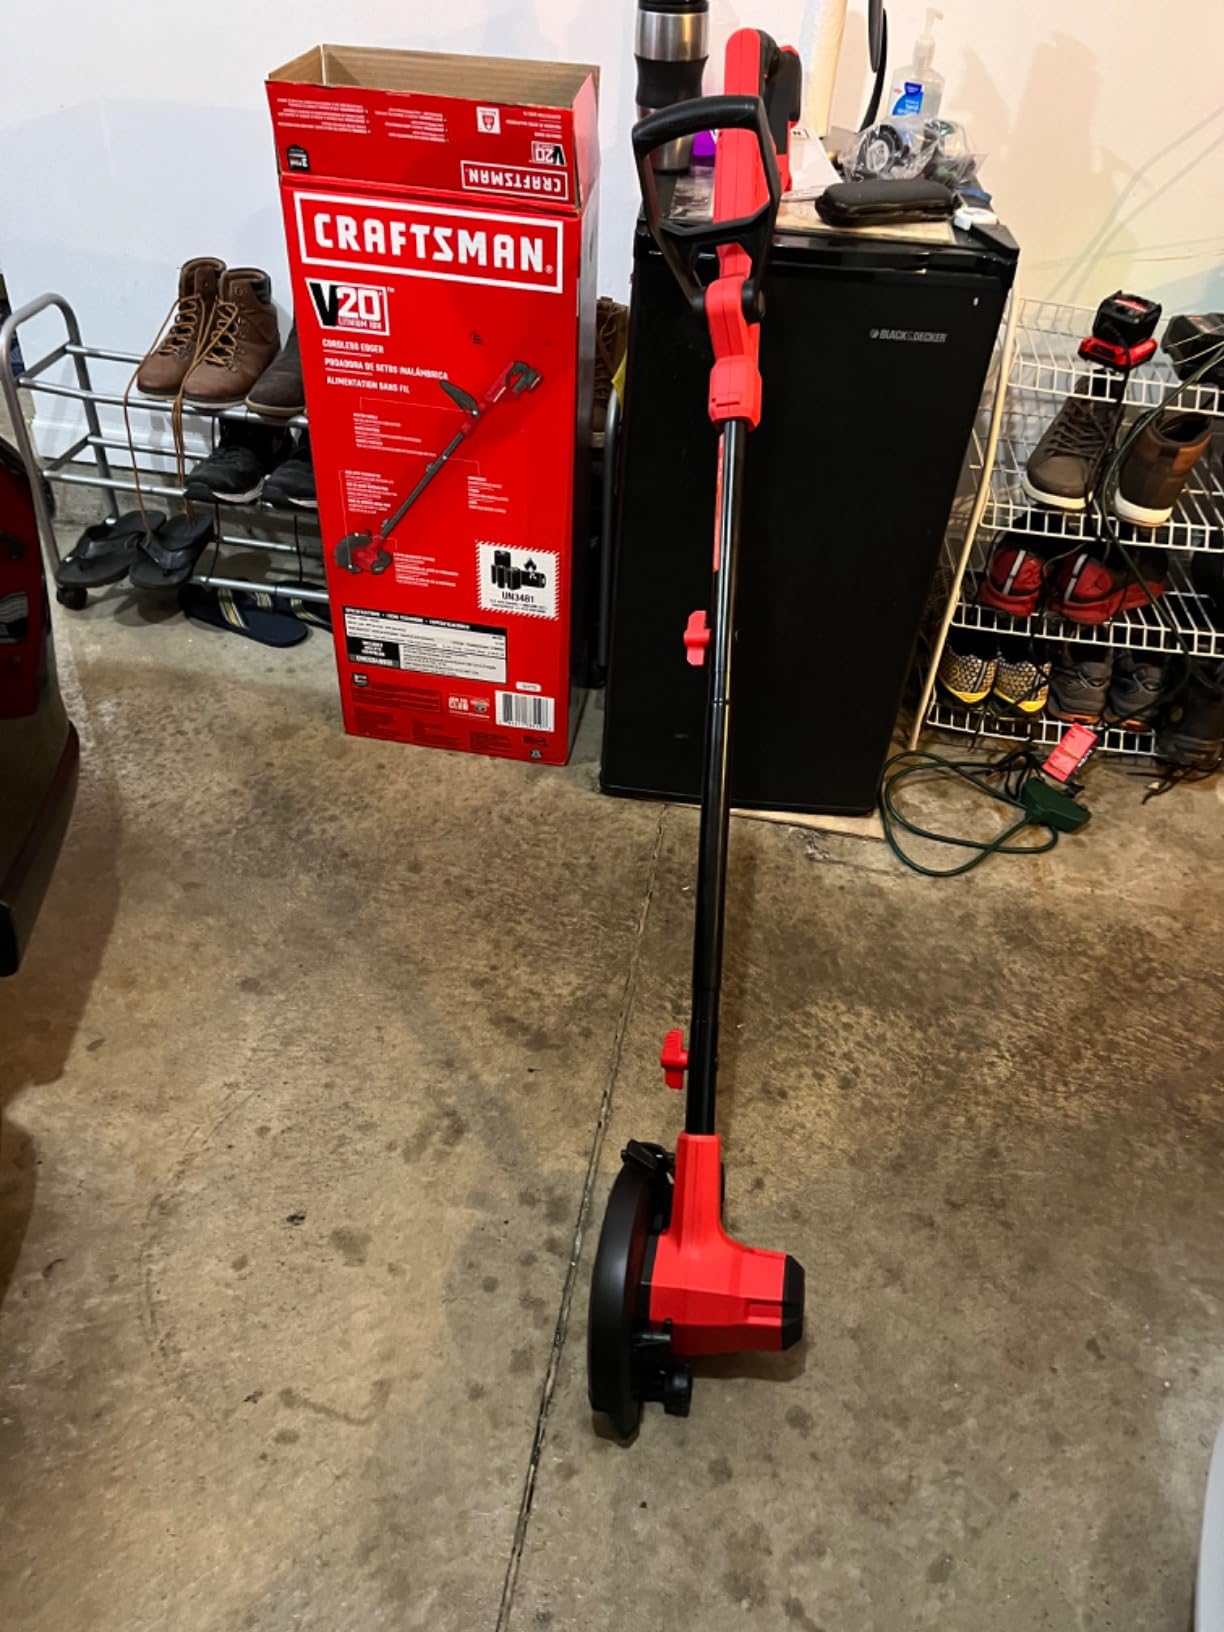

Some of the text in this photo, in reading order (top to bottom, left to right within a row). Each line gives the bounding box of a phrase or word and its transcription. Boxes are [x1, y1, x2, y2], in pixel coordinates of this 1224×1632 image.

[469, 168, 561, 192] CRAFTSMAN
[314, 213, 544, 273] CRAFTSMAN
[309, 281, 382, 328] V20
[322, 338, 384, 354] CORDLESS EDGER
[324, 357, 363, 369] PODADORA
[364, 362, 375, 371] DE
[376, 363, 398, 374] SETOS
[327, 376, 410, 394] ALIMENTATION SANS FIL
[501, 591, 534, 603] UN3481
